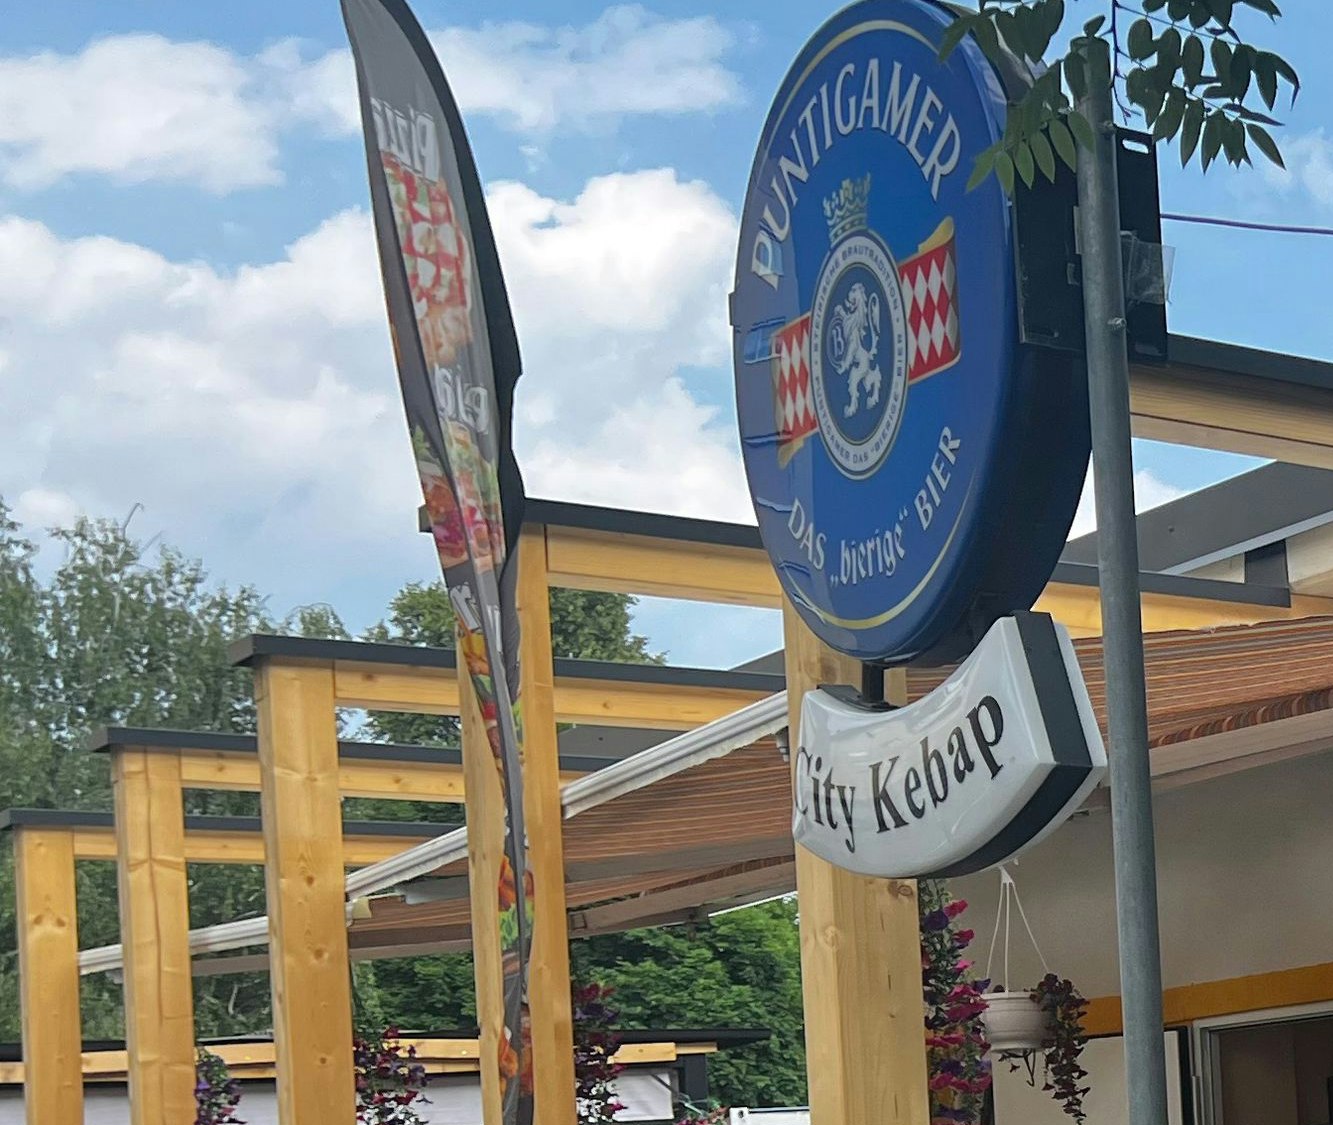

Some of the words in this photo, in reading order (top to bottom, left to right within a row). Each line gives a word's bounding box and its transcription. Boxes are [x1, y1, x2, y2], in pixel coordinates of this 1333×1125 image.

[751, 57, 962, 291] PUNTIGAMER
[786, 498, 827, 571] DAS
[914, 425, 962, 531] BIER
[795, 745, 857, 855] City
[868, 694, 1005, 835] Kebap
